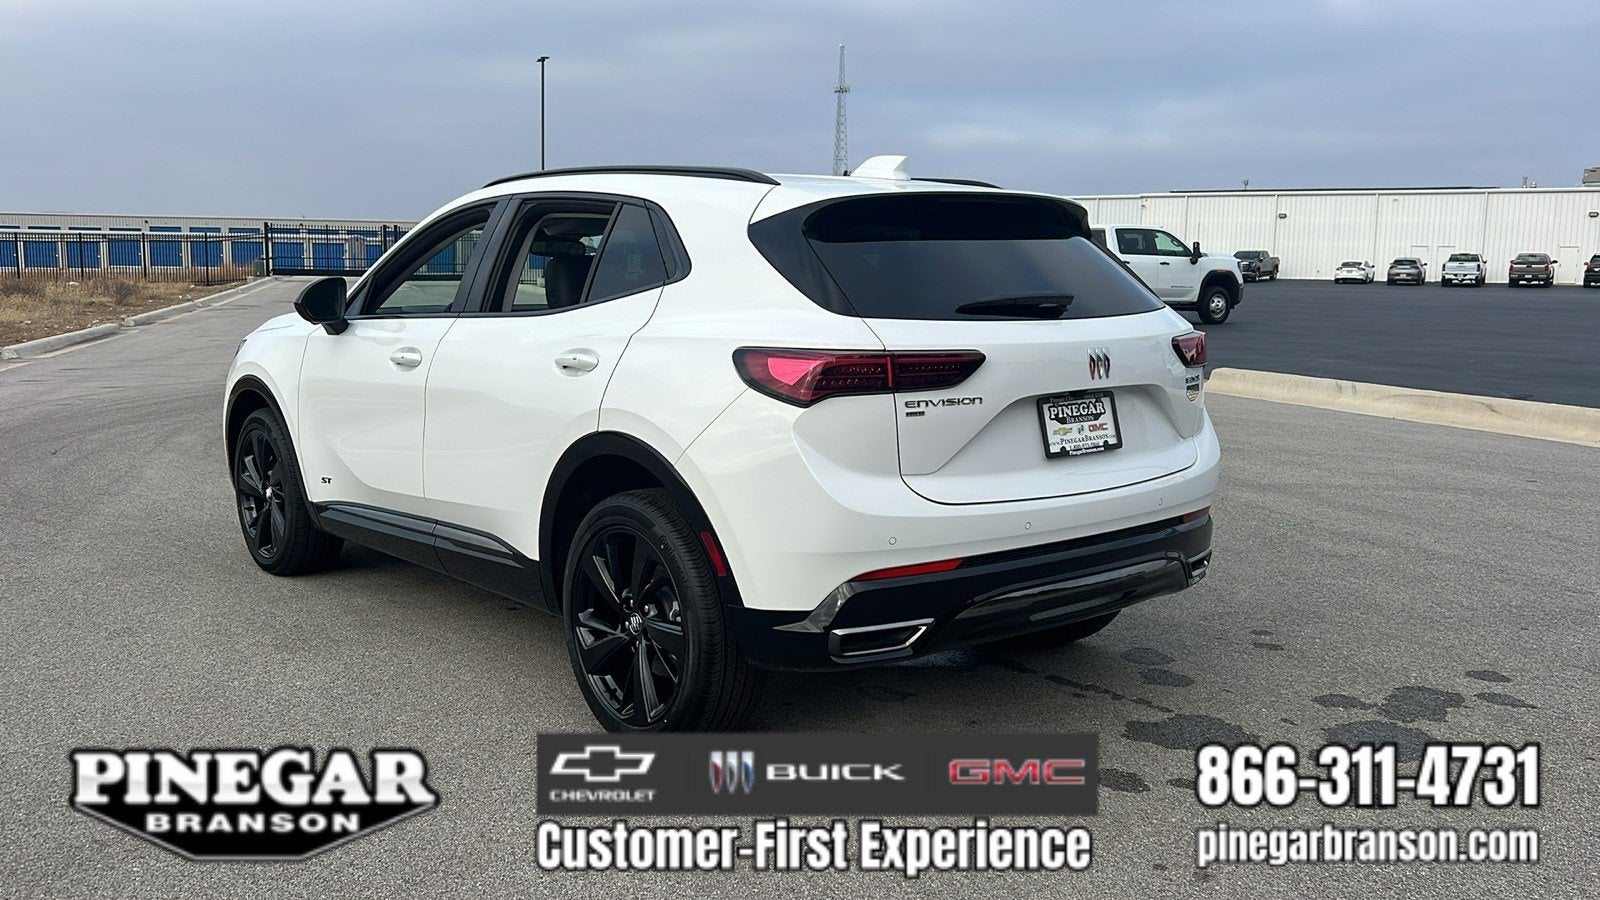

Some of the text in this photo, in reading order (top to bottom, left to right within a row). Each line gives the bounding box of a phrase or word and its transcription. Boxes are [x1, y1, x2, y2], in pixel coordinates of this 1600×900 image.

[904, 397, 983, 409] ENVISION
[1049, 402, 1105, 419] PINEGAR
[1066, 415, 1095, 424] BRANSON
[1088, 422, 1109, 433] GMC
[321, 476, 332, 484] ST
